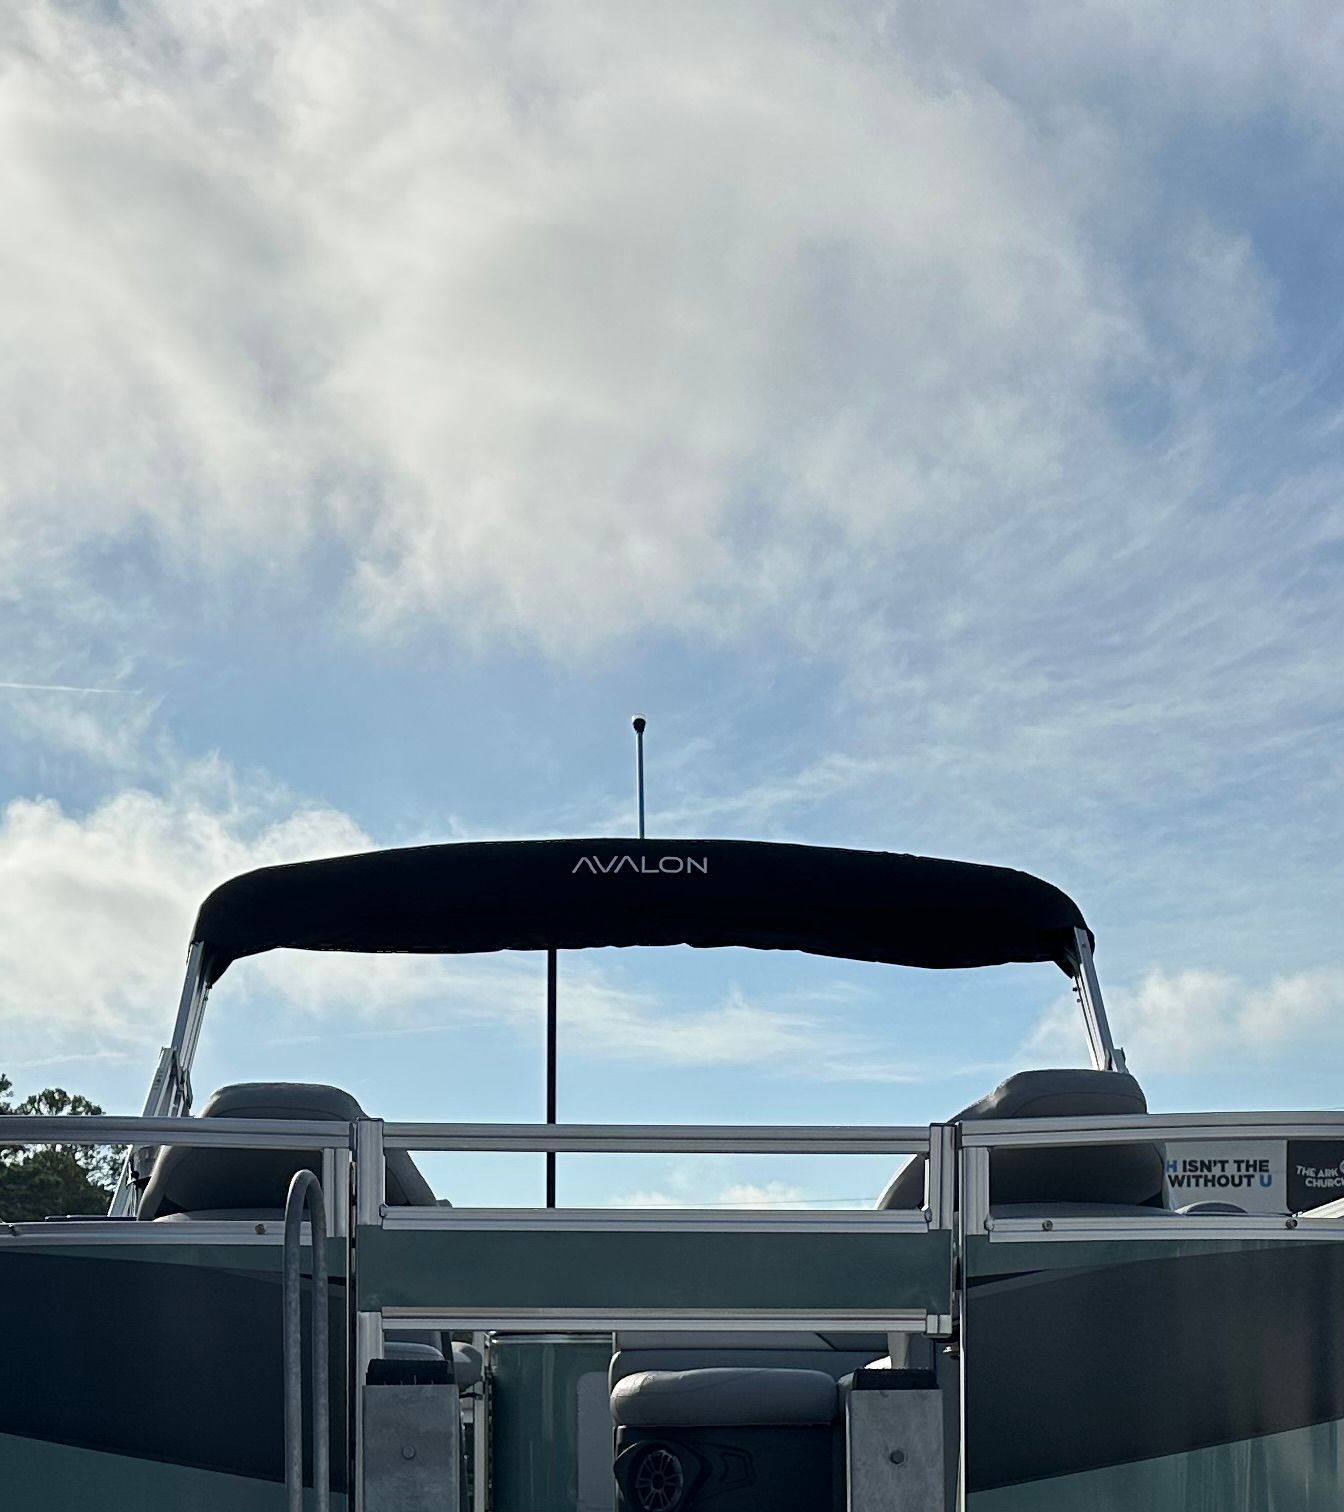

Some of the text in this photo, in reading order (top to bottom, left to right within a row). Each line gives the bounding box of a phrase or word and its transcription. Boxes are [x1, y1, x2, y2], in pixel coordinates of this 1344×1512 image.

[571, 855, 708, 874] AVALON
[1233, 1160, 1270, 1173] THE
[1295, 1165, 1338, 1178] THE ARK
[1167, 1174, 1272, 1188] WITHOUT U
